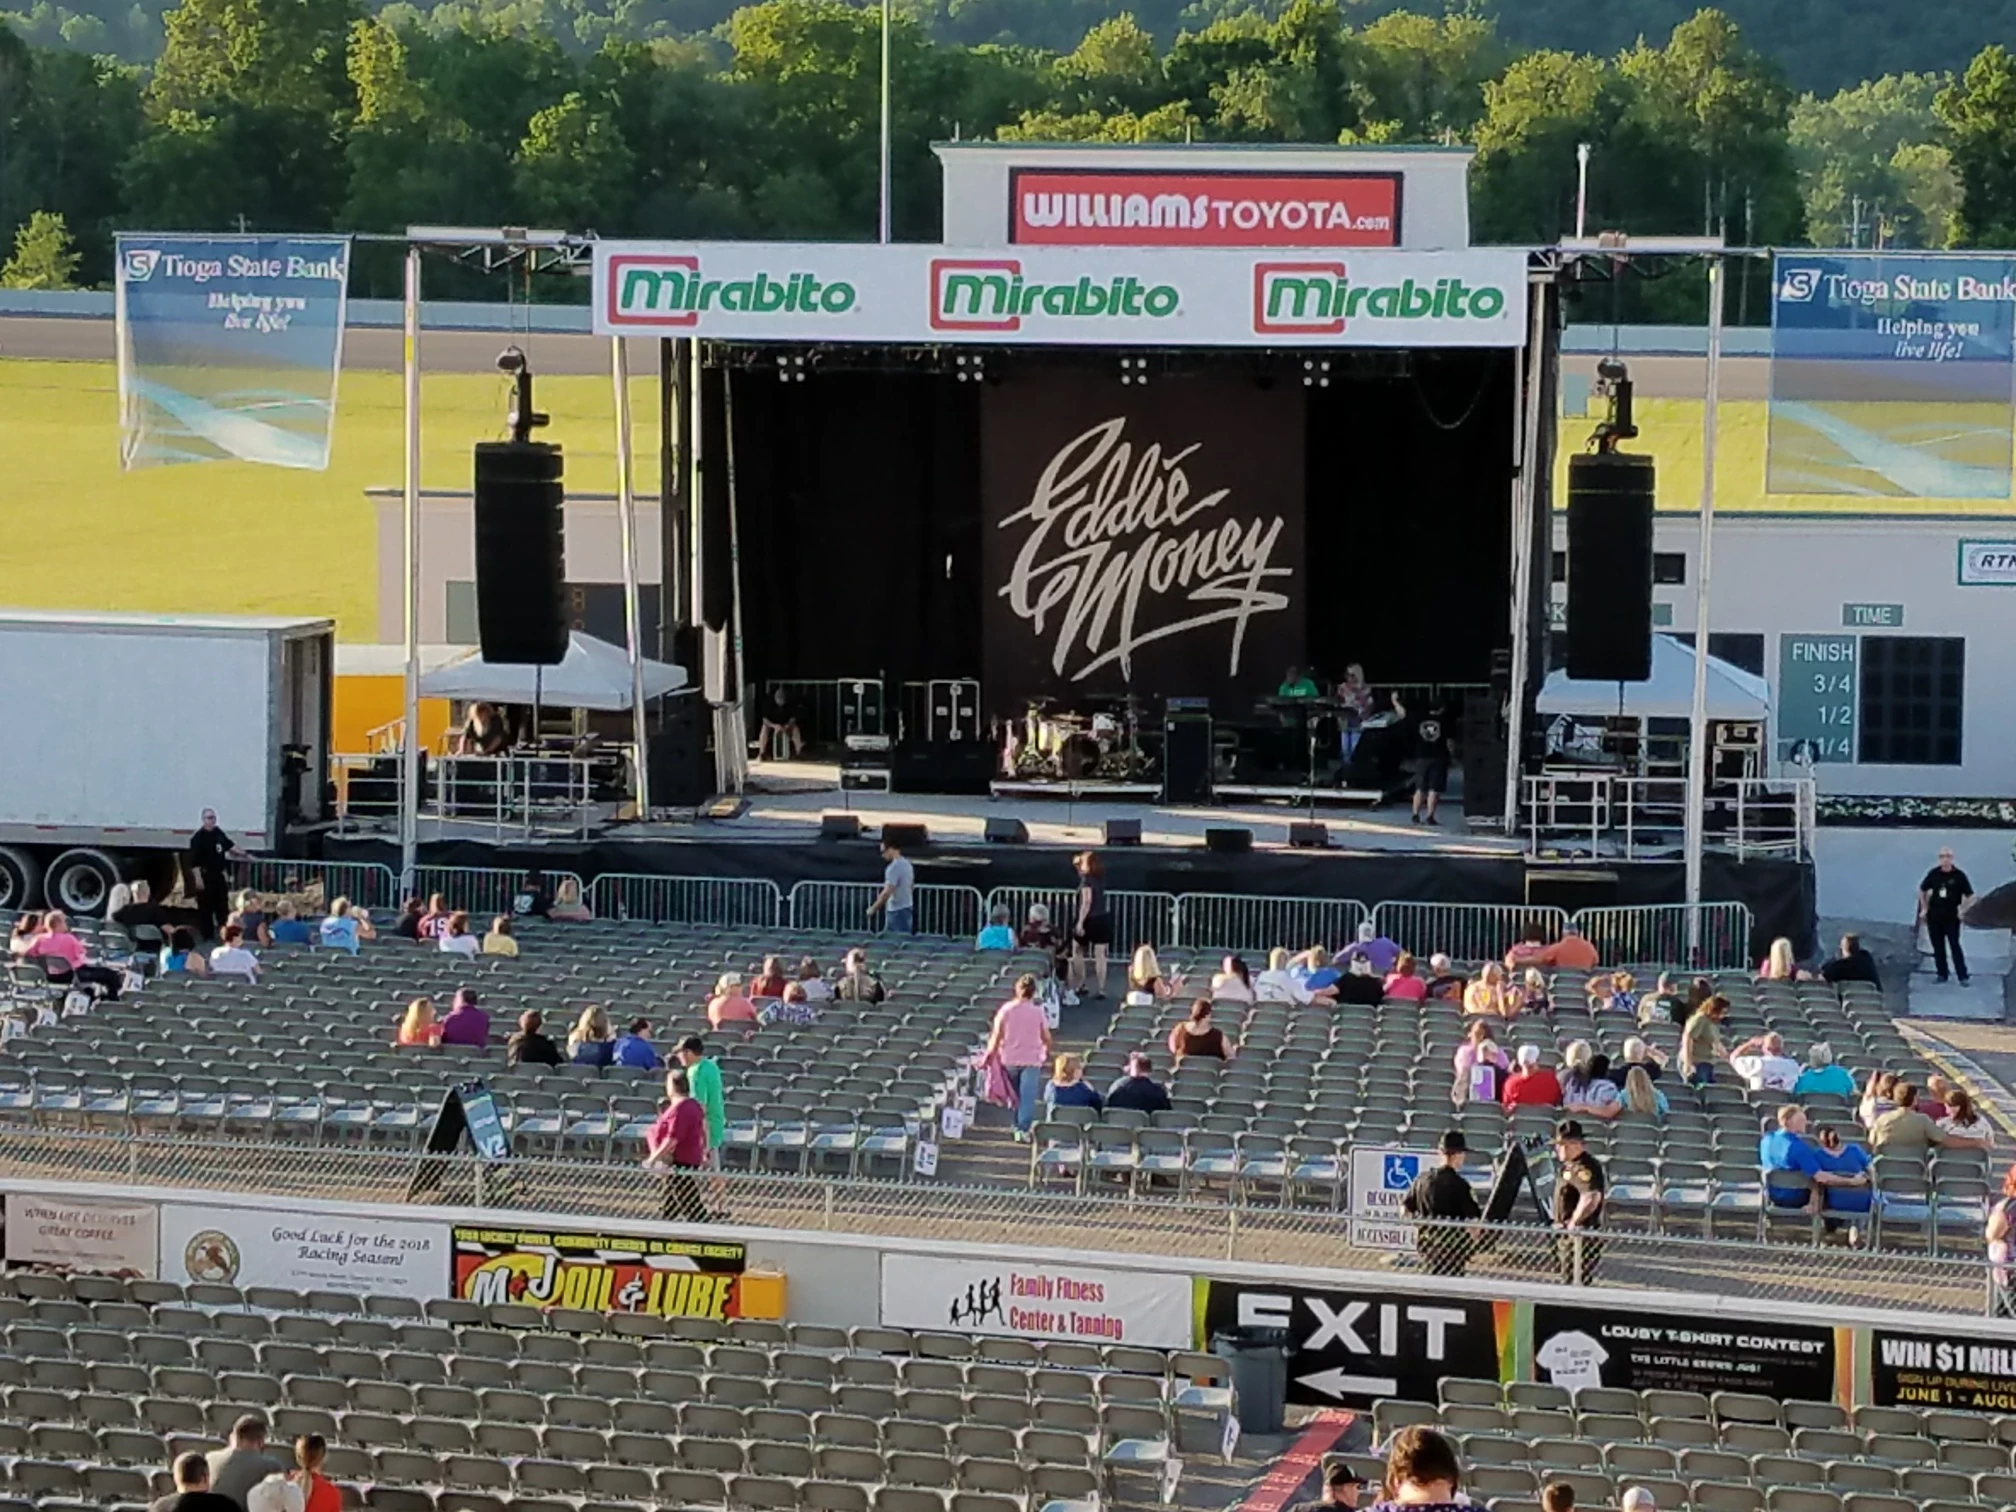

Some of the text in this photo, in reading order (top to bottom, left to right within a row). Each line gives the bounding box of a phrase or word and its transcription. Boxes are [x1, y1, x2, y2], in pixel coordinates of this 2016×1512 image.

[1023, 193, 1209, 229] WILLIAMS
[161, 254, 345, 281] Tioga State Bank
[620, 270, 856, 313] Mirabito
[943, 274, 1180, 317] Mirabito
[1267, 278, 1505, 319] Mirabito
[1824, 274, 2016, 305] Tioga State Bank
[1877, 318, 1980, 340] Helping you
[1895, 341, 1964, 362] live life!
[998, 416, 1231, 595] Eddie
[1030, 516, 1293, 682] Money
[1853, 606, 1892, 623] TIME
[1792, 643, 1853, 662] FINISH
[1814, 674, 1851, 693] 3/4
[1818, 707, 1852, 724] 1/2
[272, 1227, 306, 1241] Good
[344, 1233, 369, 1249] for
[374, 1233, 396, 1249] the
[399, 1239, 431, 1251] 2018
[297, 1245, 405, 1267] Racing Season!
[562, 1265, 615, 1312] OIL
[645, 1271, 732, 1319] LUBE
[1010, 1273, 1104, 1303] Family Fitness
[1009, 1306, 1123, 1341] Center & Tanning
[1237, 1292, 1467, 1360] EXIT
[1736, 1335, 1826, 1355] CONTEST
[1881, 1338, 1932, 1368] WIN
[1935, 1341, 1965, 1372] $1
[1926, 1375, 1943, 1386] UP
[1896, 1387, 1941, 1403] JUNE
[1945, 1390, 1953, 1404] 1
